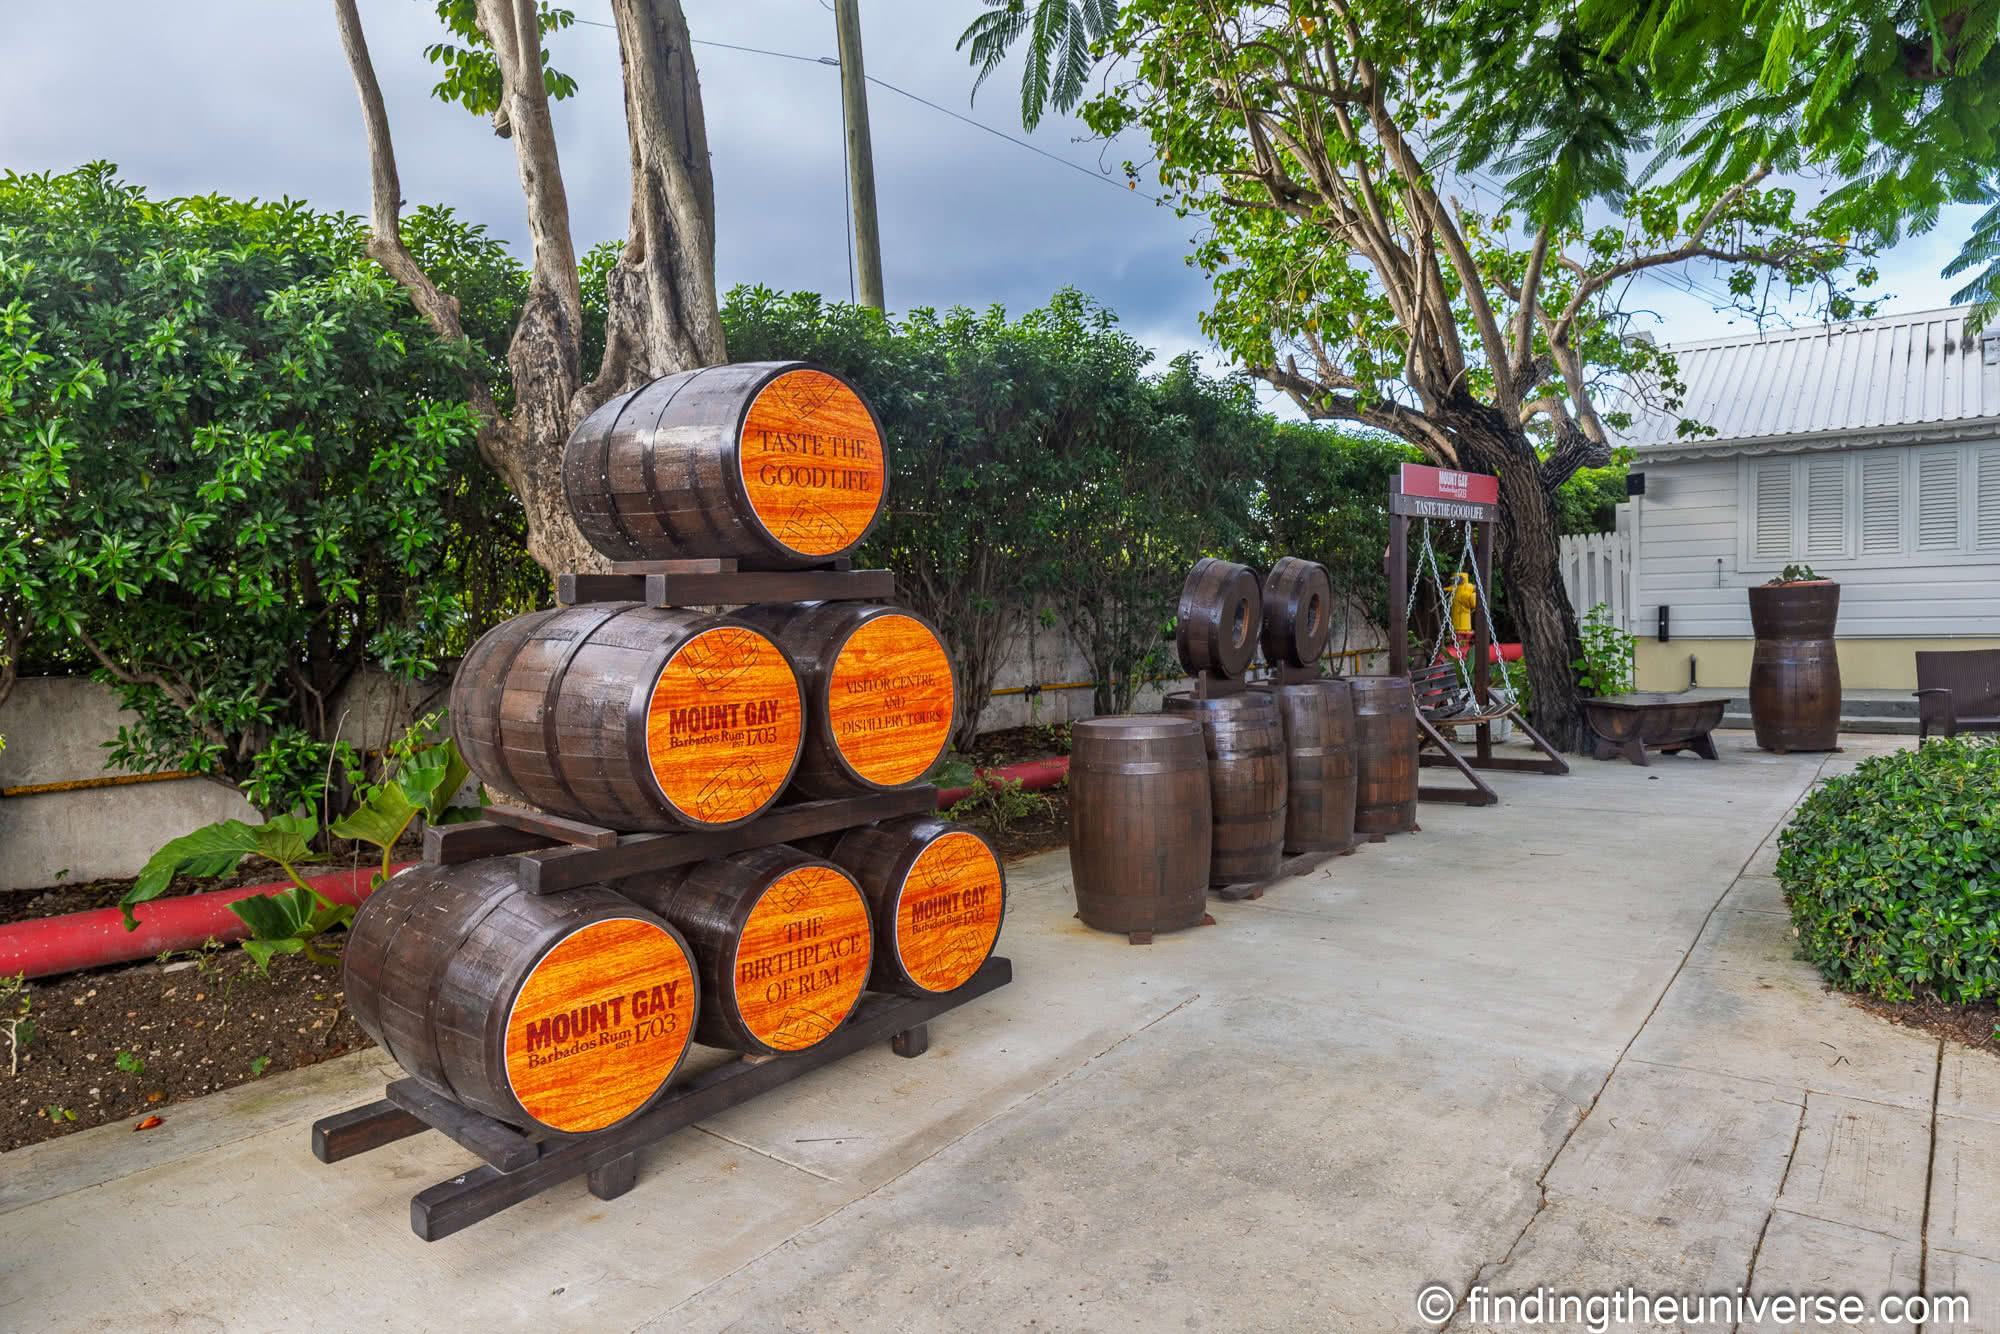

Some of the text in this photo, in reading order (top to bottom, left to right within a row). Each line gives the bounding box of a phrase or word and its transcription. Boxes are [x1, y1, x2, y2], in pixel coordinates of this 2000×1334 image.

[757, 430, 868, 459] TASTE THE
[760, 464, 871, 491] GOOD LIFE
[1439, 471, 1457, 486] MOUNT
[1415, 501, 1484, 519] TASTE THE GOOD LIFE
[846, 673, 936, 694] VISITOR CENTRE
[883, 696, 905, 710] AND
[669, 700, 779, 734] MOUNT GAY
[842, 711, 942, 735] DISTILLERY TOURS
[670, 727, 777, 749] Barbados Rum 1703
[912, 885, 987, 923] MOUNT GAY
[784, 916, 825, 943] THE
[741, 934, 862, 984] BIRTHPLACE
[766, 965, 840, 1004] OF RUM
[526, 979, 679, 1052] MOUNT GAY
[528, 1013, 677, 1069] Barbados Rum 1703
